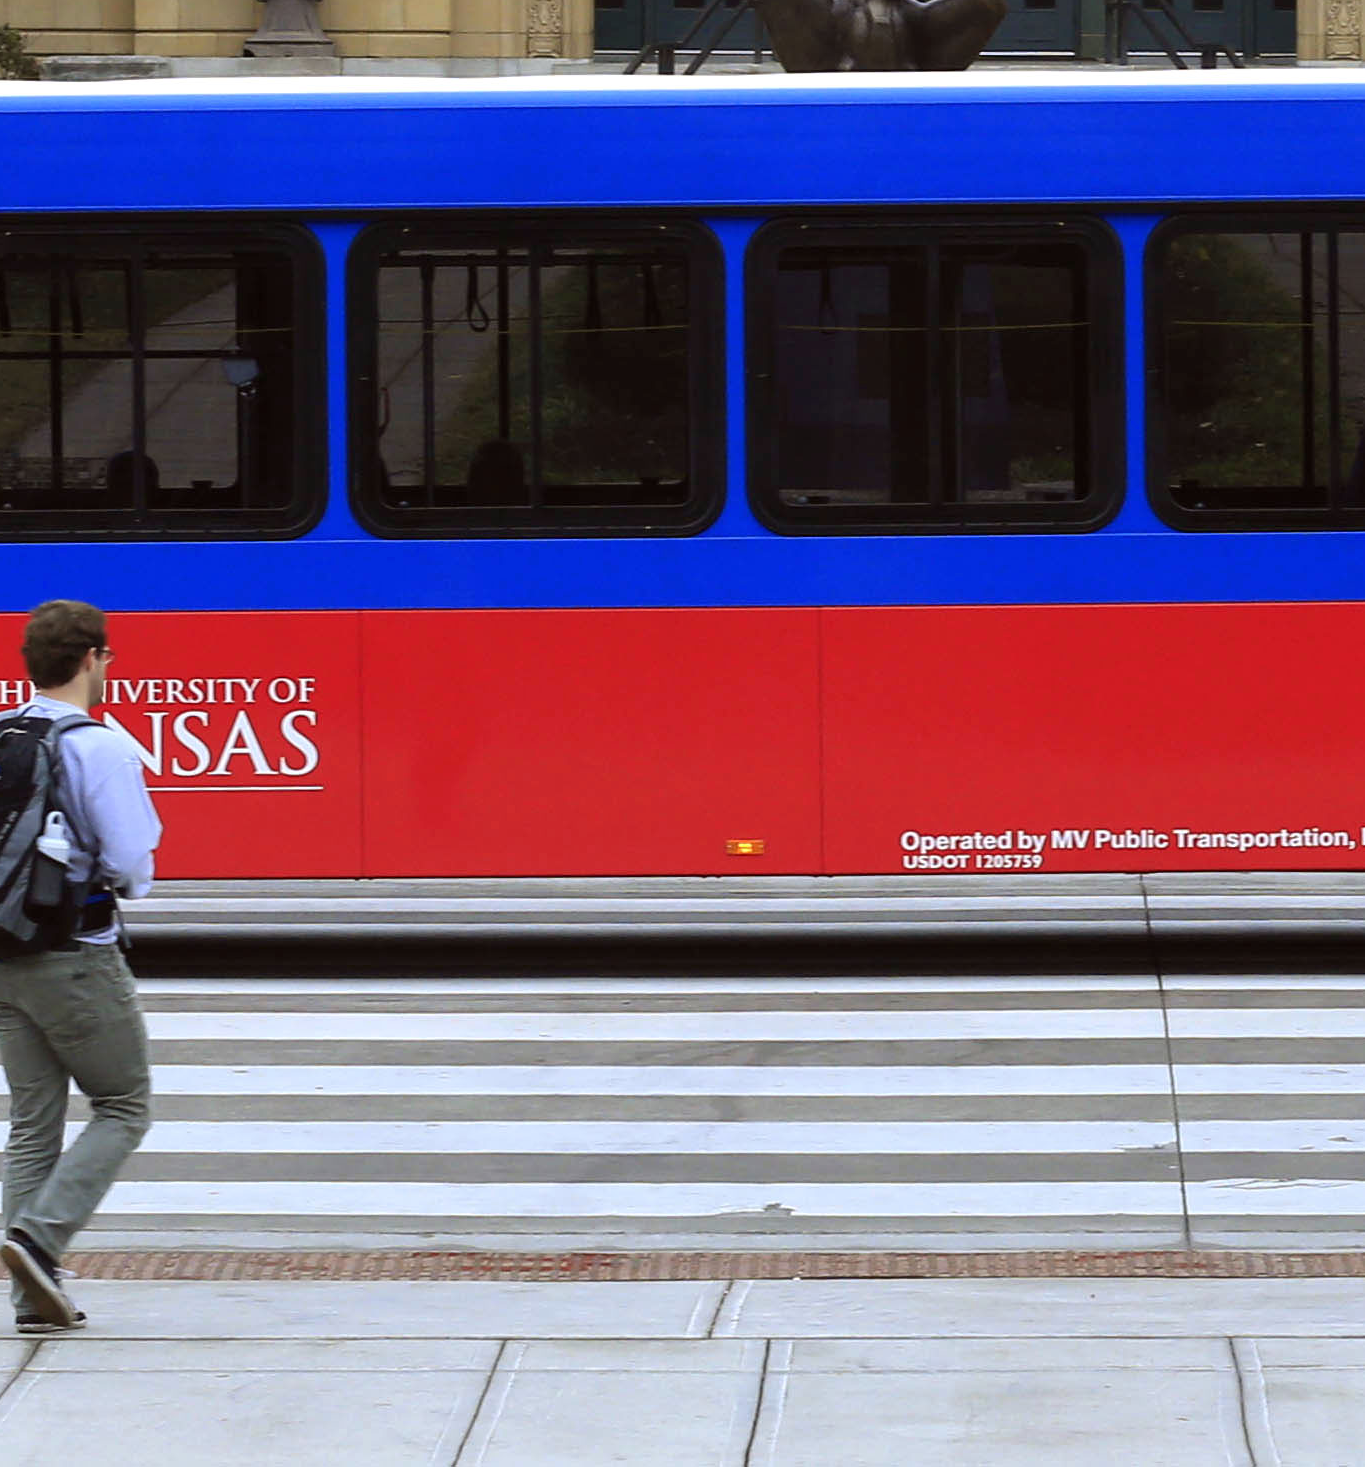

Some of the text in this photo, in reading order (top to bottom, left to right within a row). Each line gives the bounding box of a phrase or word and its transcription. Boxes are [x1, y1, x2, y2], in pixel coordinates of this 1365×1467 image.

[101, 679, 262, 704] IVERSITY
[267, 677, 316, 704] OF
[900, 831, 1013, 853] Operated
[1017, 831, 1047, 853] by
[1050, 830, 1090, 849] MV
[1094, 829, 1169, 849] Public
[1172, 828, 1356, 851] Transportation,
[902, 854, 1043, 869] USDOT 1205759
